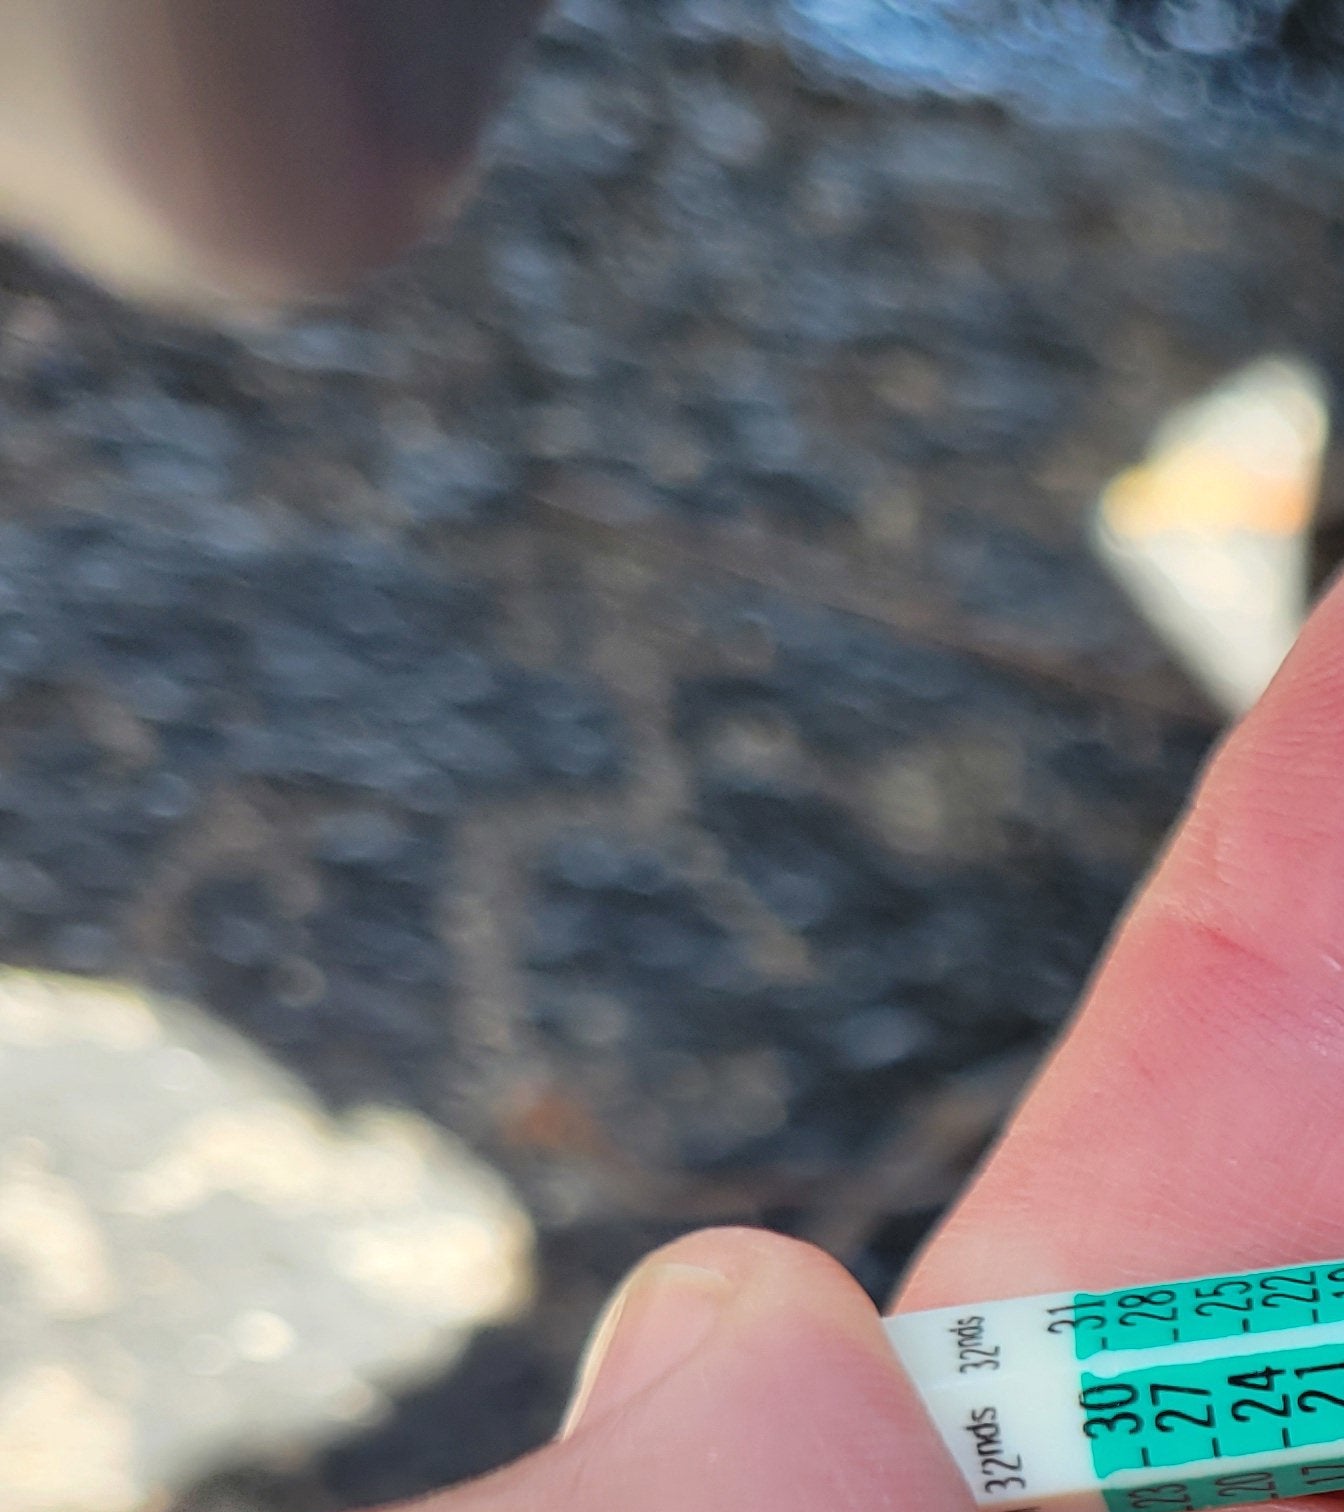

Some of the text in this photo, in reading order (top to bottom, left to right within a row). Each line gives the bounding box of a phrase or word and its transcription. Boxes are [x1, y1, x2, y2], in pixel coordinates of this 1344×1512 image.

[1195, 1280, 1256, 1316] 25
[1261, 1270, 1319, 1308] 22
[1048, 1301, 1107, 1335] 31
[1117, 1290, 1178, 1328] 28
[947, 1315, 1000, 1374] 32nds
[1078, 1383, 1143, 1440] 30
[1150, 1383, 1215, 1433] 27
[1227, 1366, 1293, 1425] 24
[965, 1406, 1026, 1494] 32nds
[1129, 1482, 1192, 1510] 23
[1215, 1471, 1276, 1498] 20
